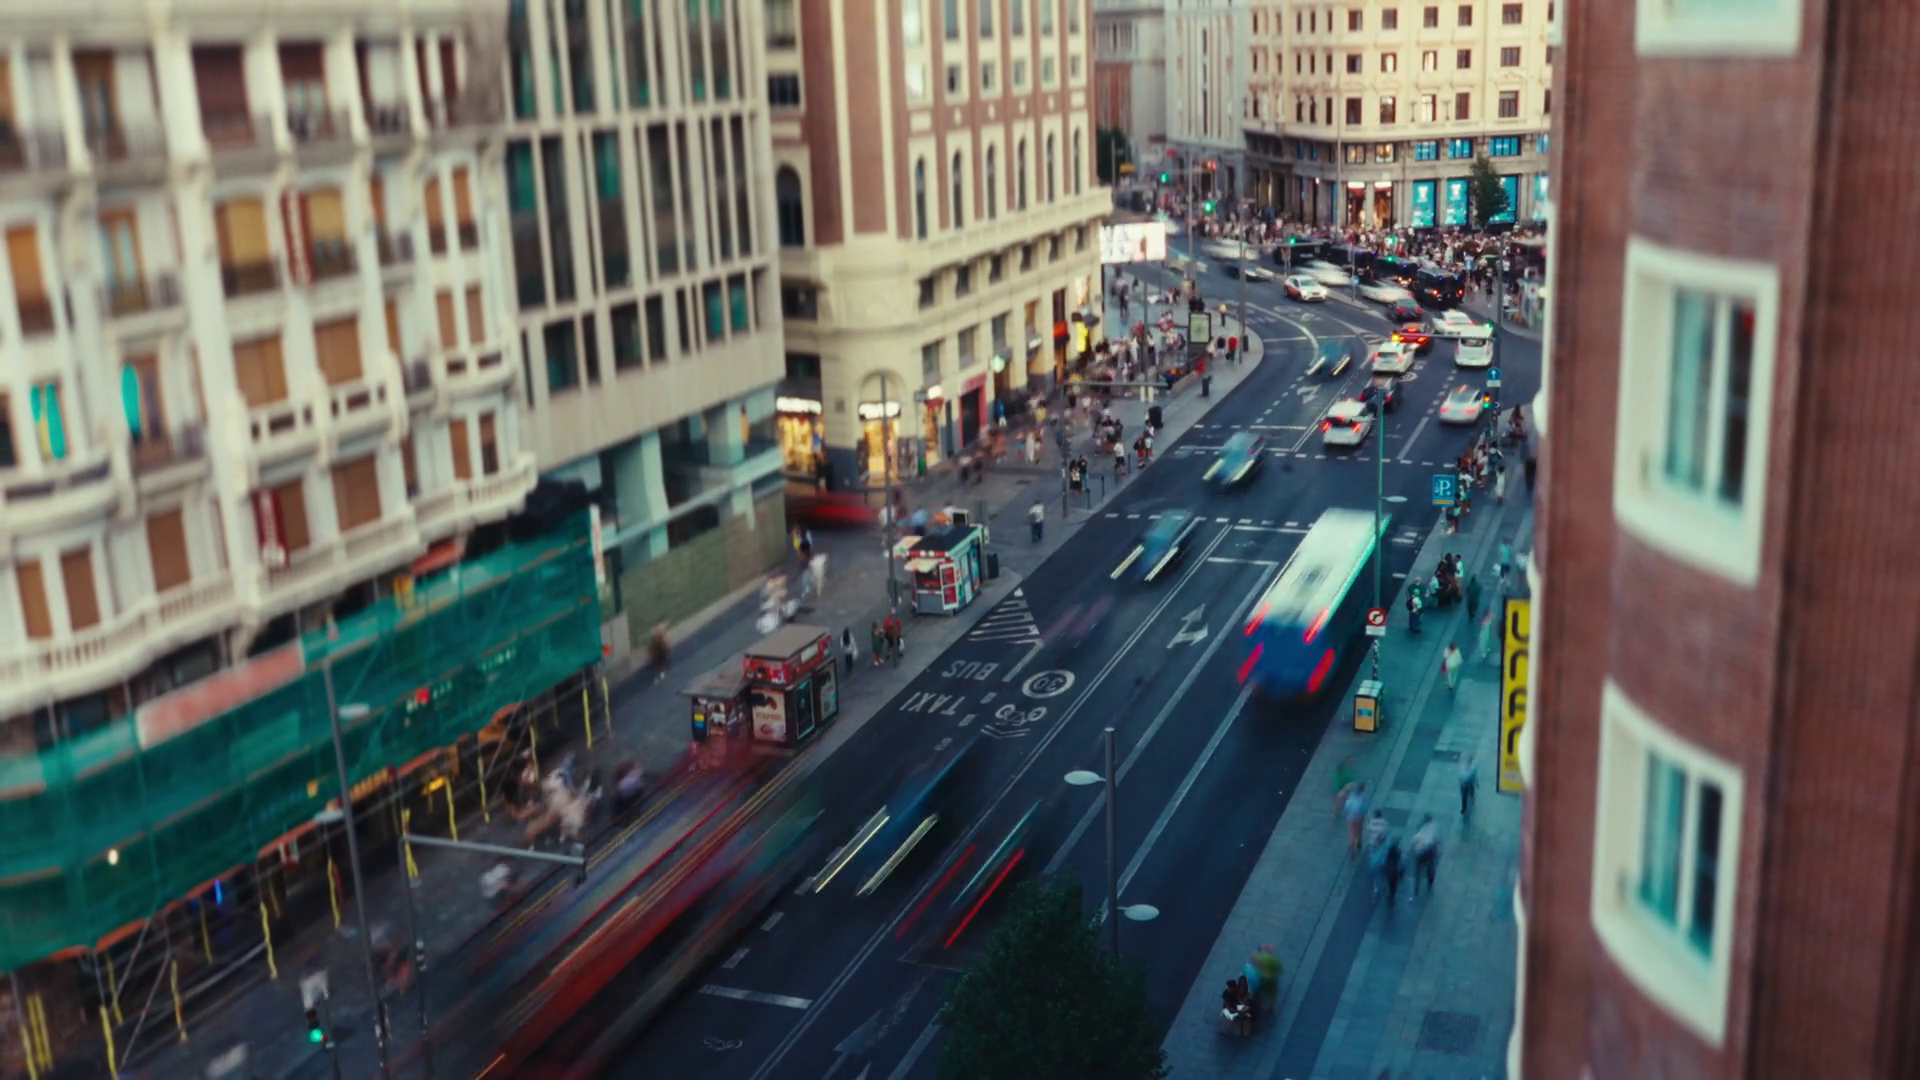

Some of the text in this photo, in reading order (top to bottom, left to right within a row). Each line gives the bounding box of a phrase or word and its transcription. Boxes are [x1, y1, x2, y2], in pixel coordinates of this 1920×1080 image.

[1438, 479, 1451, 496] P
[942, 660, 999, 680] BUS
[1033, 677, 1064, 692] 30
[900, 692, 966, 715] TAXI
